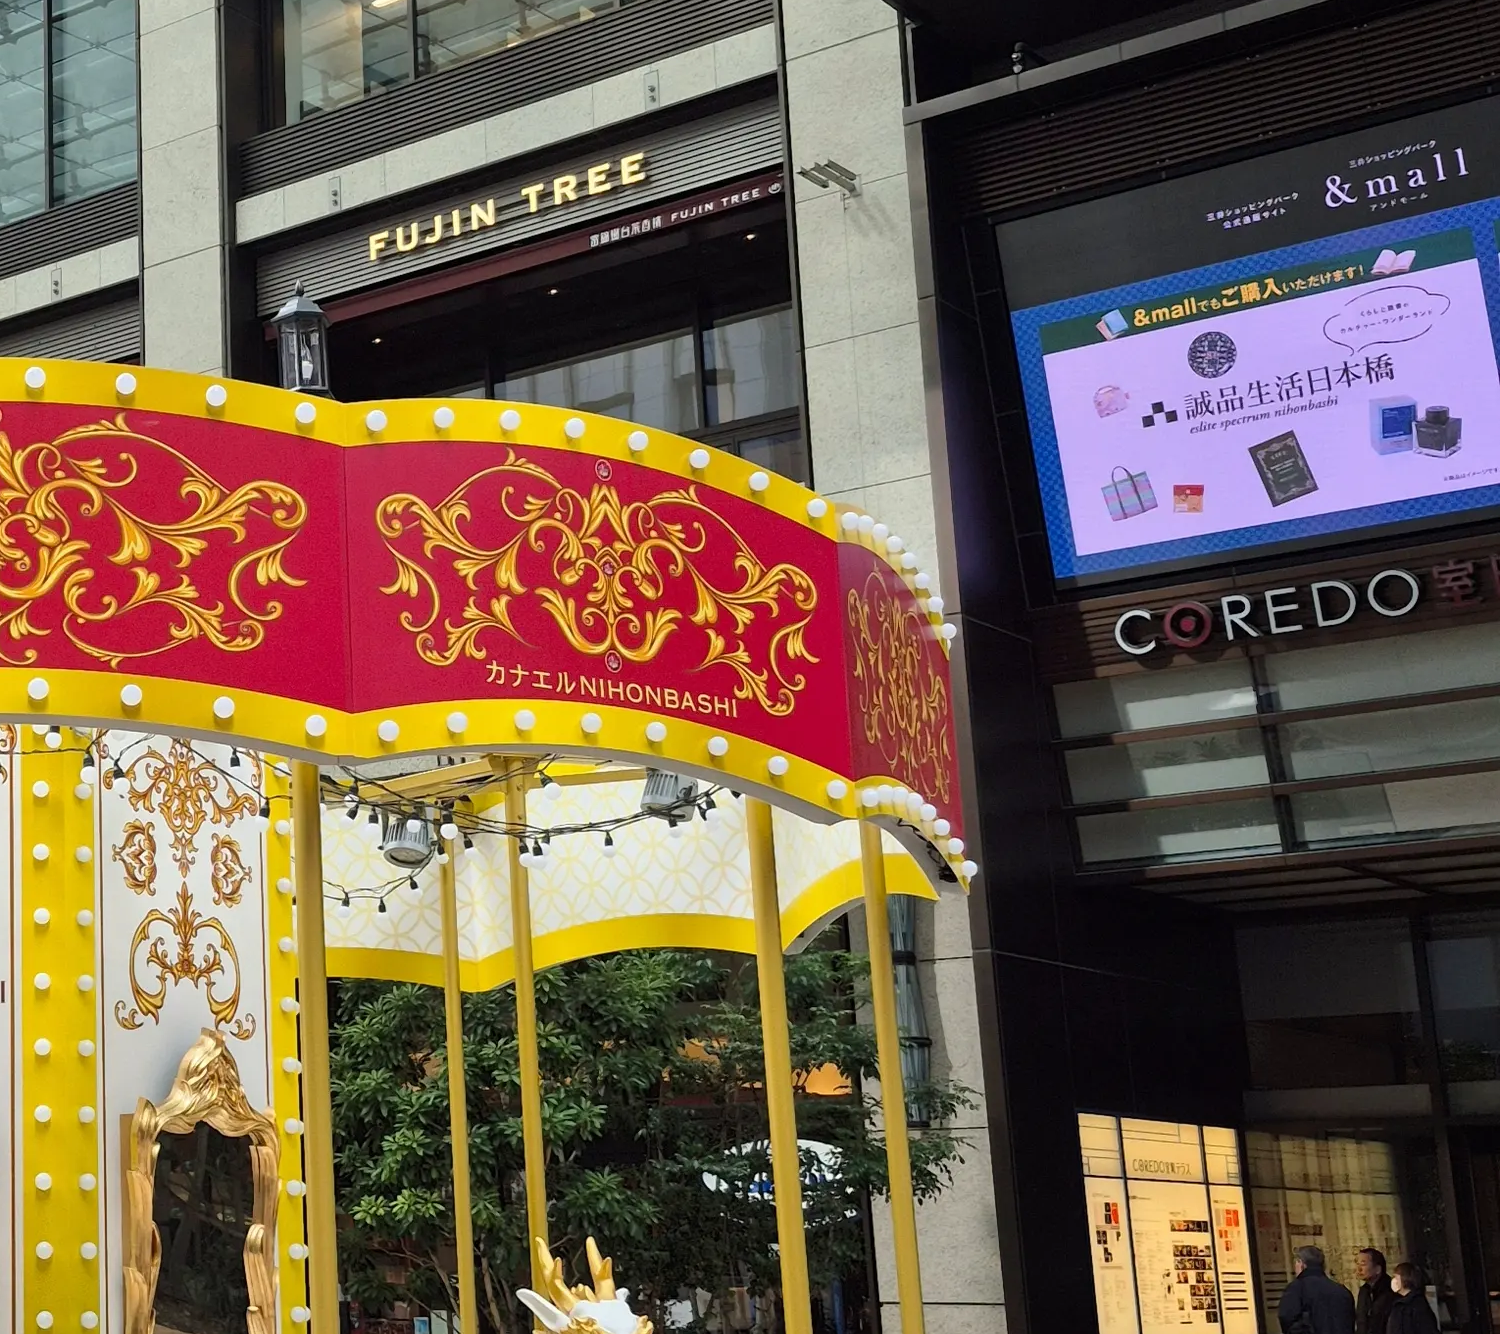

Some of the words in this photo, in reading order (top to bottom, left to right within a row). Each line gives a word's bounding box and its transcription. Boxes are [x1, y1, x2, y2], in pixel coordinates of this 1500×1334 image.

[368, 198, 496, 261] FUJIN
[521, 152, 647, 213] TREE
[670, 202, 714, 223] FUJIN
[721, 188, 761, 207] TREE
[1324, 147, 1470, 208] &mall
[1184, 353, 1395, 420] 誠品生活日本橋
[1189, 420, 1218, 435] eslite
[1220, 411, 1272, 432] spectrum
[1273, 395, 1339, 418] nihonbashi
